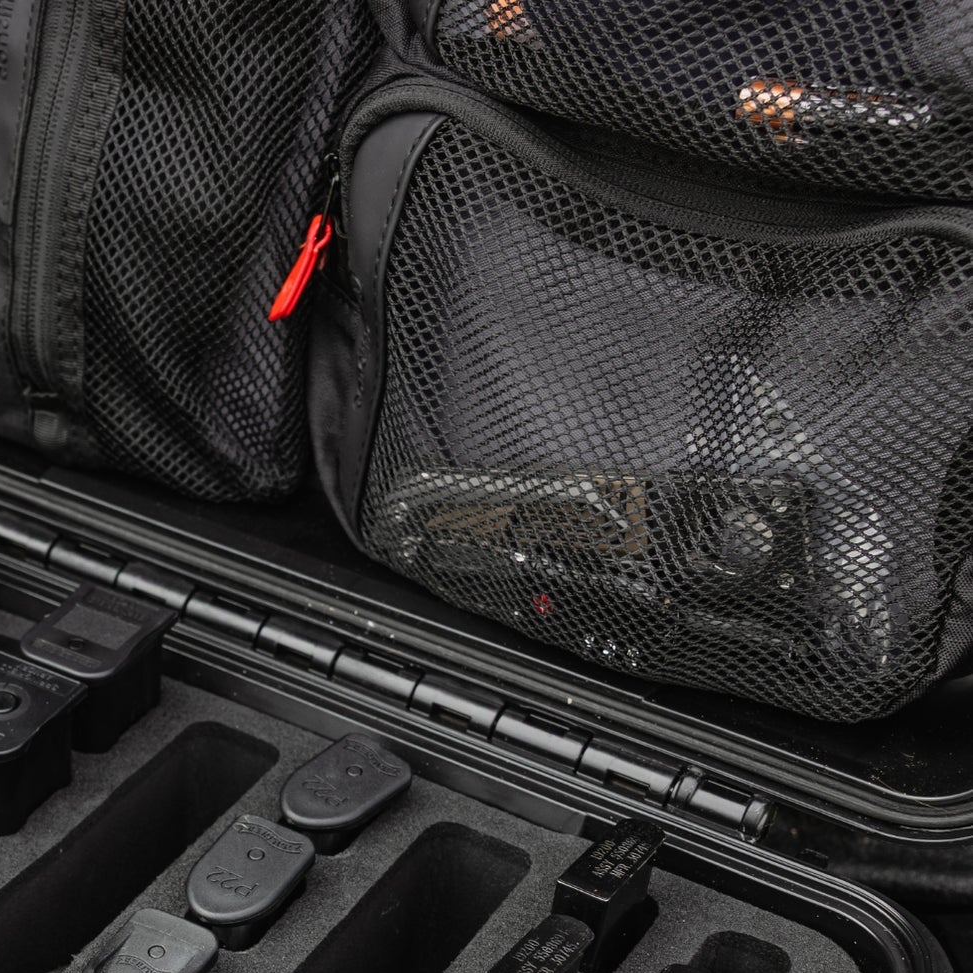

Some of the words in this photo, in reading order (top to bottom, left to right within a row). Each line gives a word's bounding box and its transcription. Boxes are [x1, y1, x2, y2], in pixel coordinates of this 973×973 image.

[302, 774, 348, 808] P22
[206, 866, 260, 898] P22
[591, 858, 615, 878] ASSY
